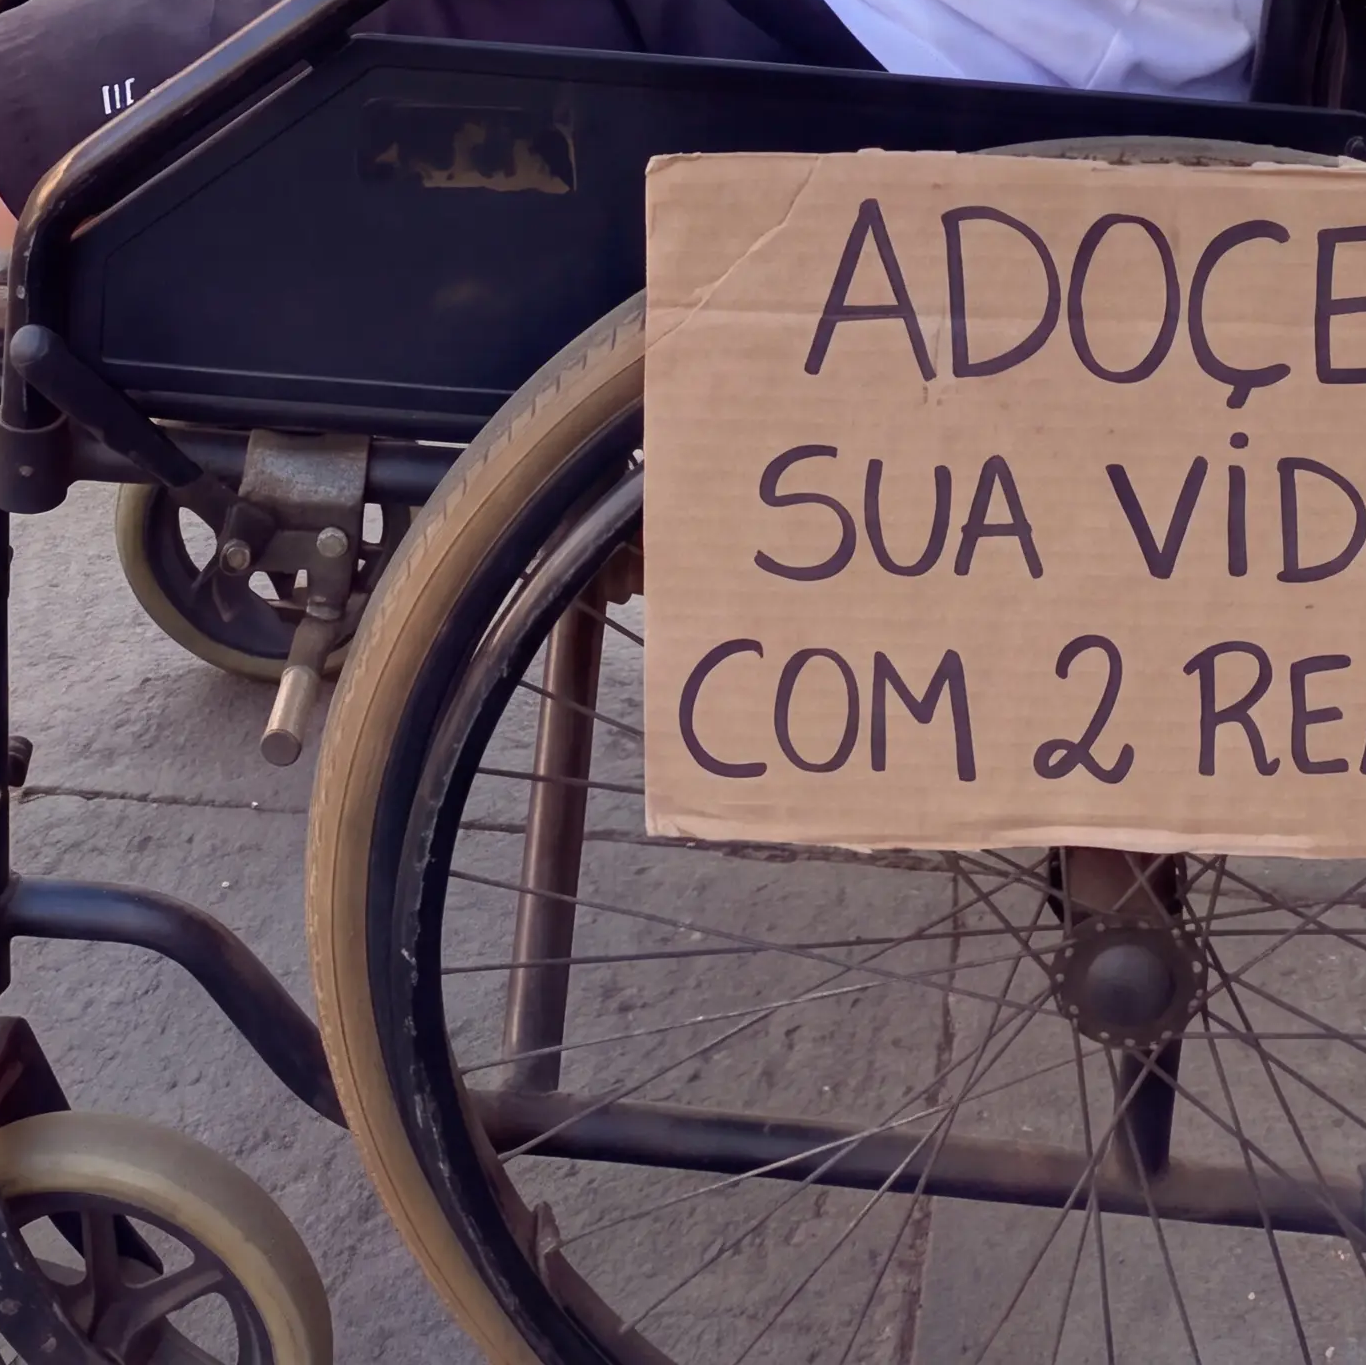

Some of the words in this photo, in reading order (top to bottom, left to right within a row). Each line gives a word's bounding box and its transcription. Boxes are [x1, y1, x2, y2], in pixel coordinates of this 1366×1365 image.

[754, 445, 1043, 581] SUA
[679, 639, 976, 782] COM
[1034, 635, 1134, 784] 2
